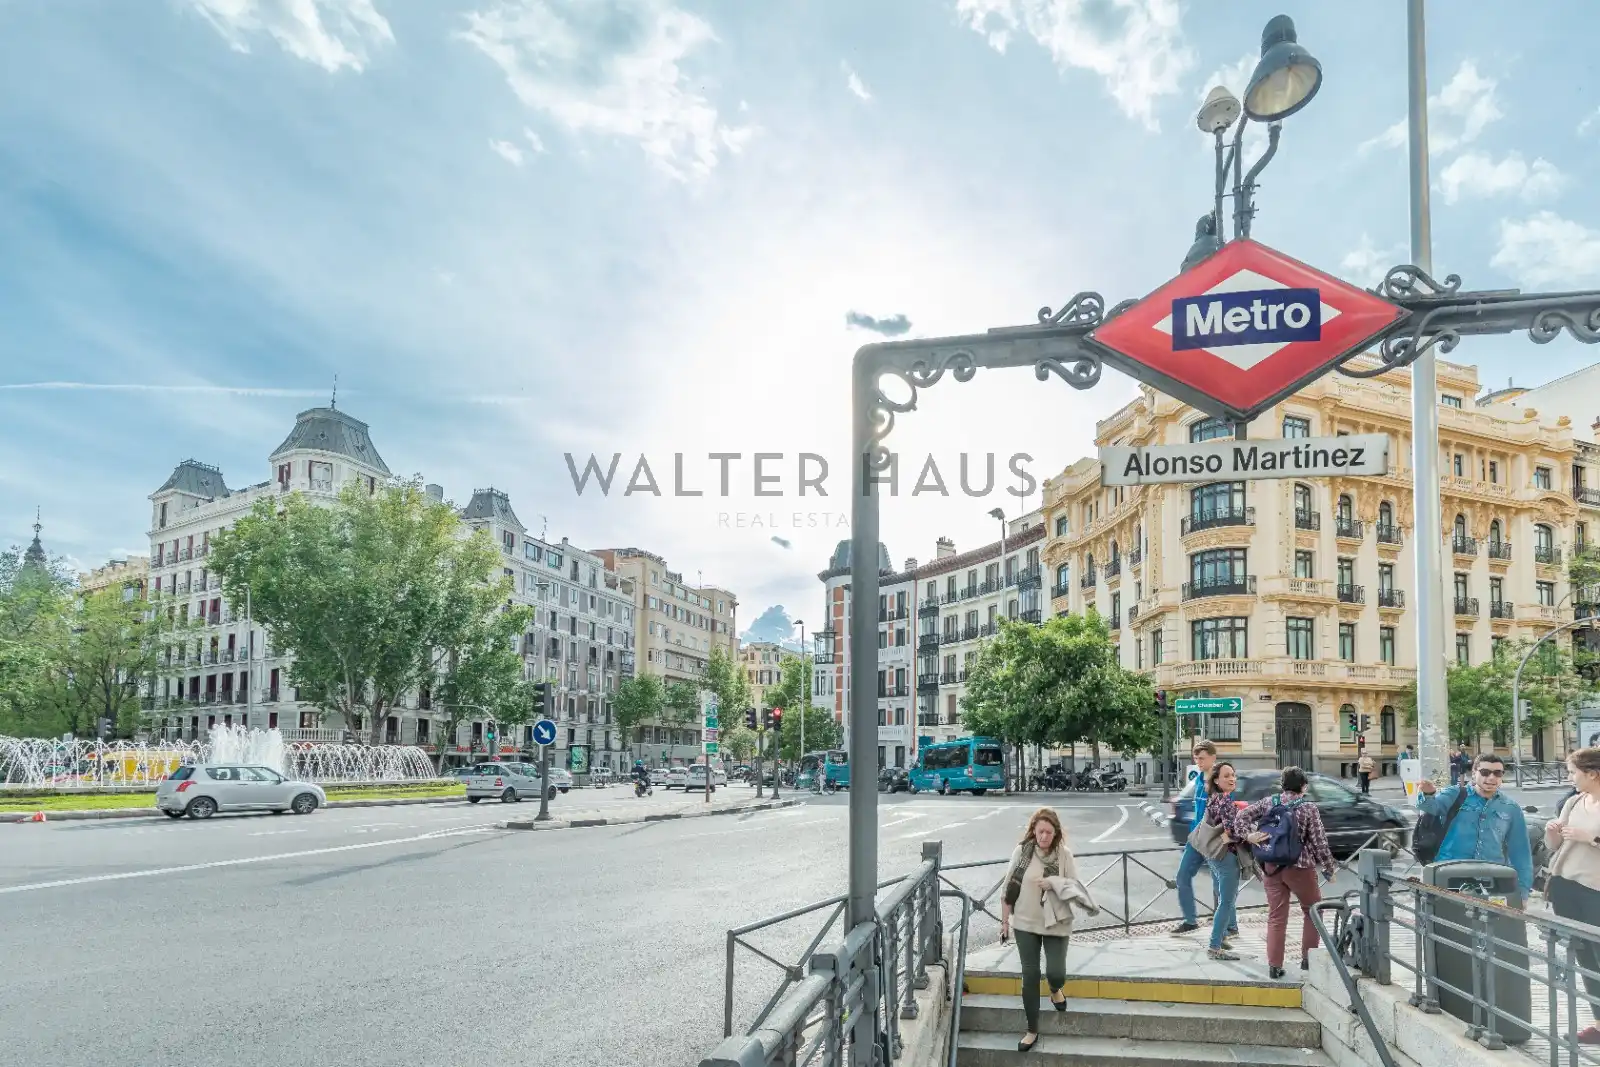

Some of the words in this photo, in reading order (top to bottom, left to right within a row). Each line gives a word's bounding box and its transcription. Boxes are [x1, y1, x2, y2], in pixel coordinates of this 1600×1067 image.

[1186, 299, 1311, 338] Metro
[1123, 452, 1223, 477] Alonso
[1232, 443, 1366, 472] Martínez
